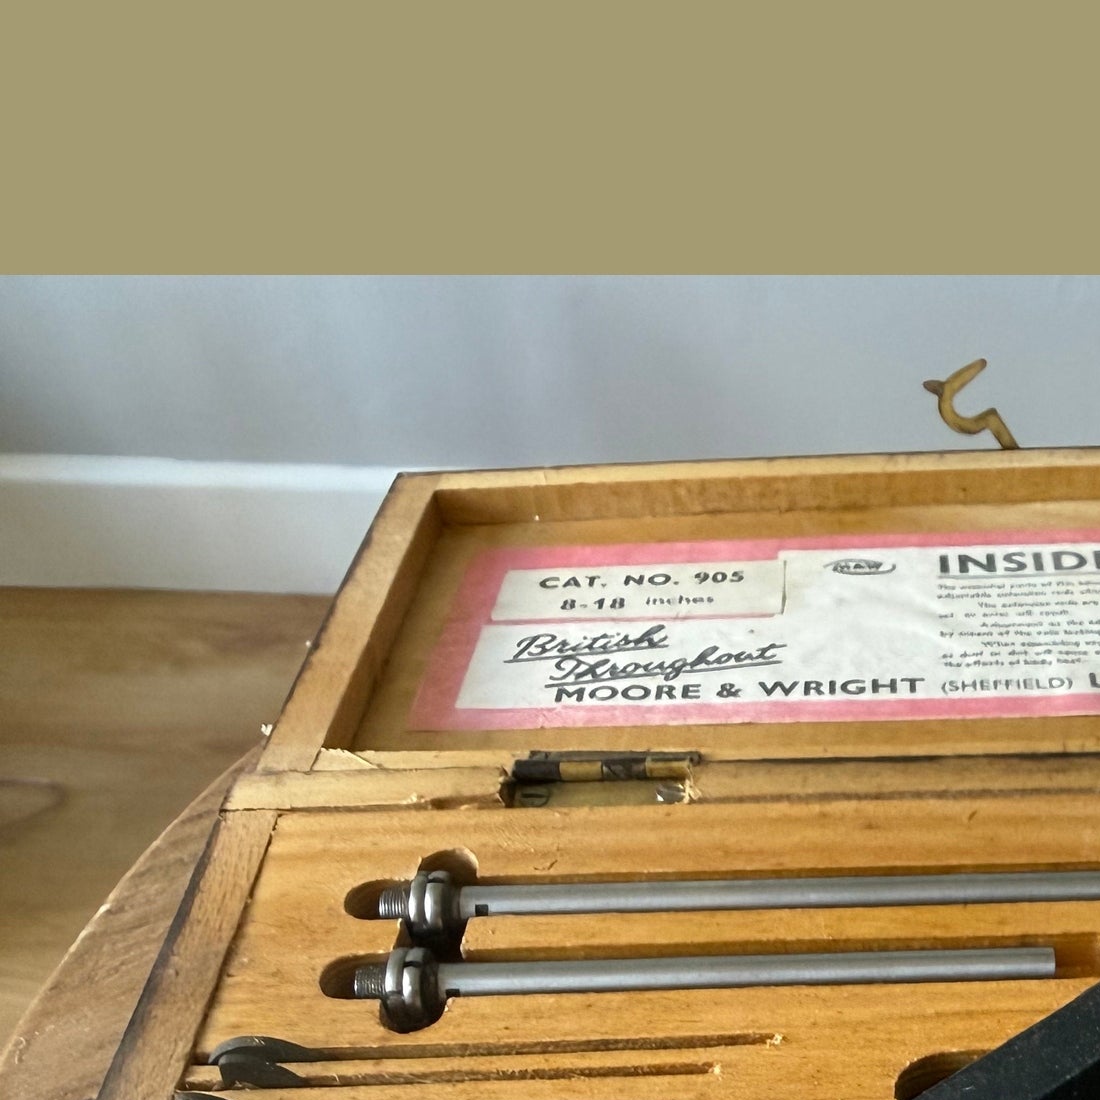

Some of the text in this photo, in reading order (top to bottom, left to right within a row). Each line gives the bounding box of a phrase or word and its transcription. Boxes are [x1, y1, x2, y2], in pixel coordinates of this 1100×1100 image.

[538, 570, 746, 590] CAT. NO. 905
[559, 594, 715, 611] 8-18 inches
[513, 622, 671, 661] British
[548, 643, 788, 682] Throughout
[553, 683, 702, 703] MOORE
[715, 682, 742, 699] &
[757, 677, 927, 698] WRIGHT
[940, 675, 1074, 695] (SHEFFIELD)
